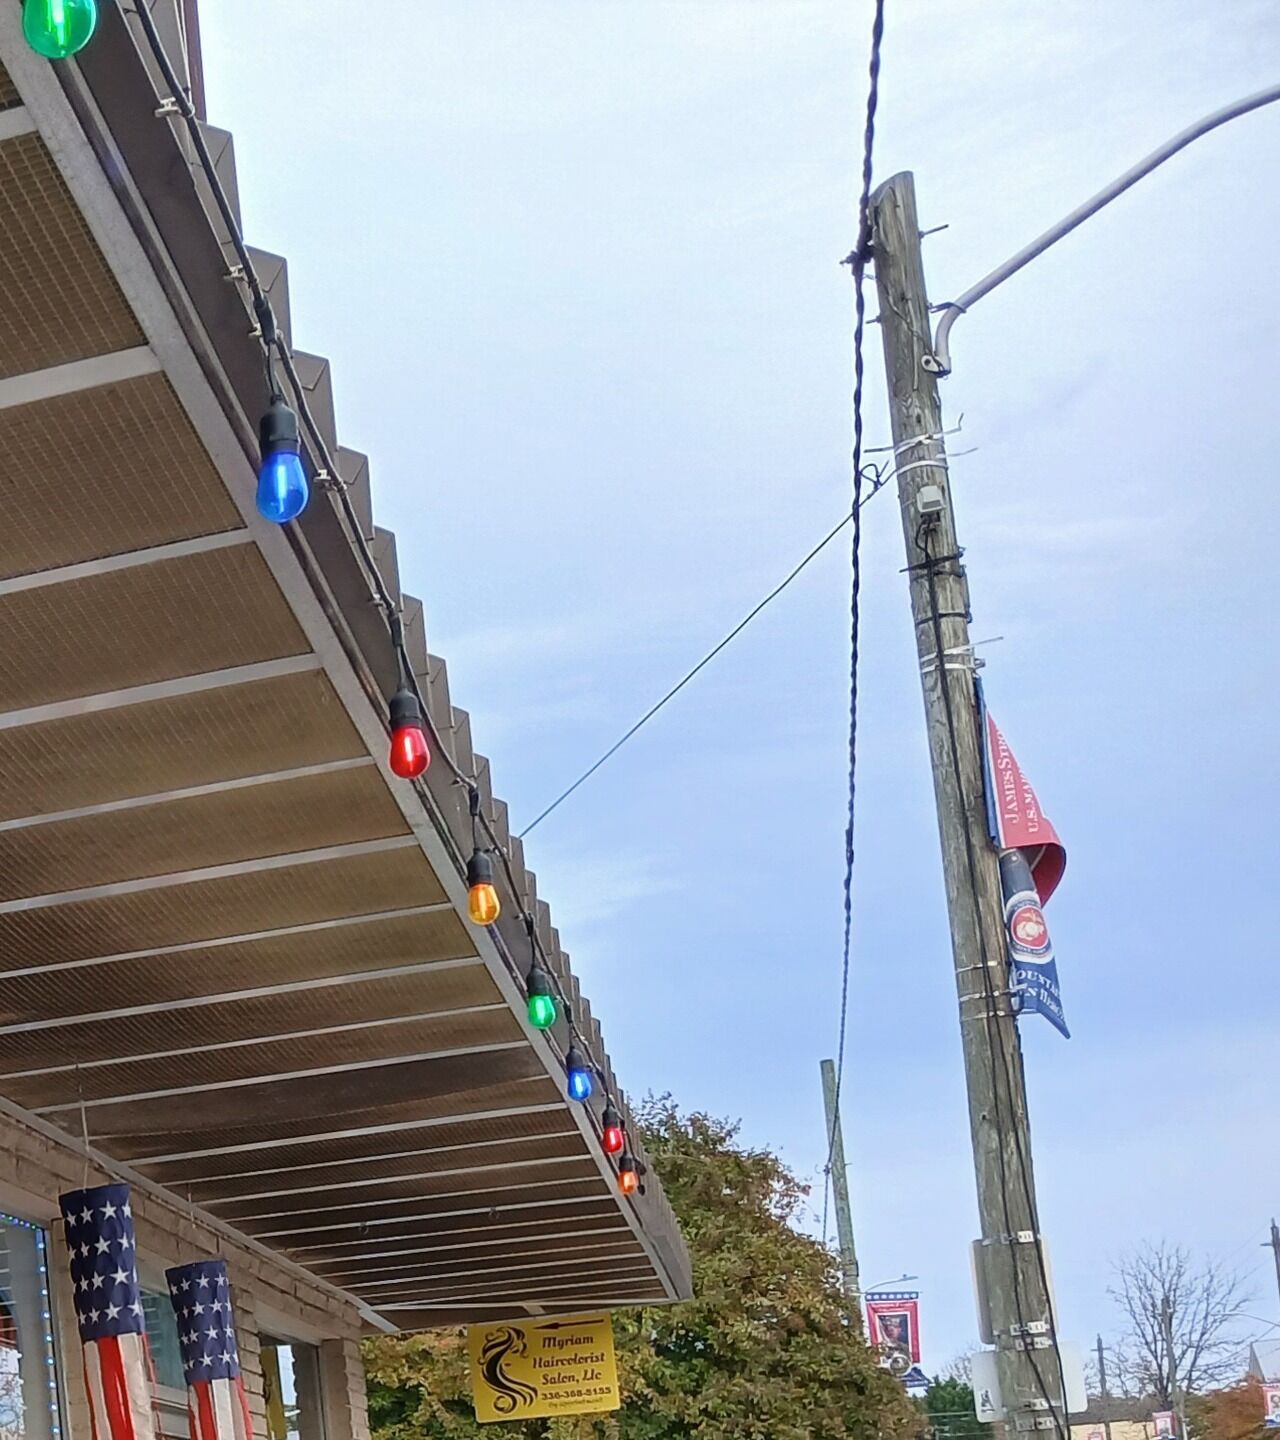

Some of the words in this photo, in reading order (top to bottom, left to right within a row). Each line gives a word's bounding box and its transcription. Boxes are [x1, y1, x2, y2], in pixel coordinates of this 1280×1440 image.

[542, 1335, 594, 1350] Myriam
[532, 1352, 606, 1368] Haircolorist
[541, 1371, 580, 1386] Salon,
